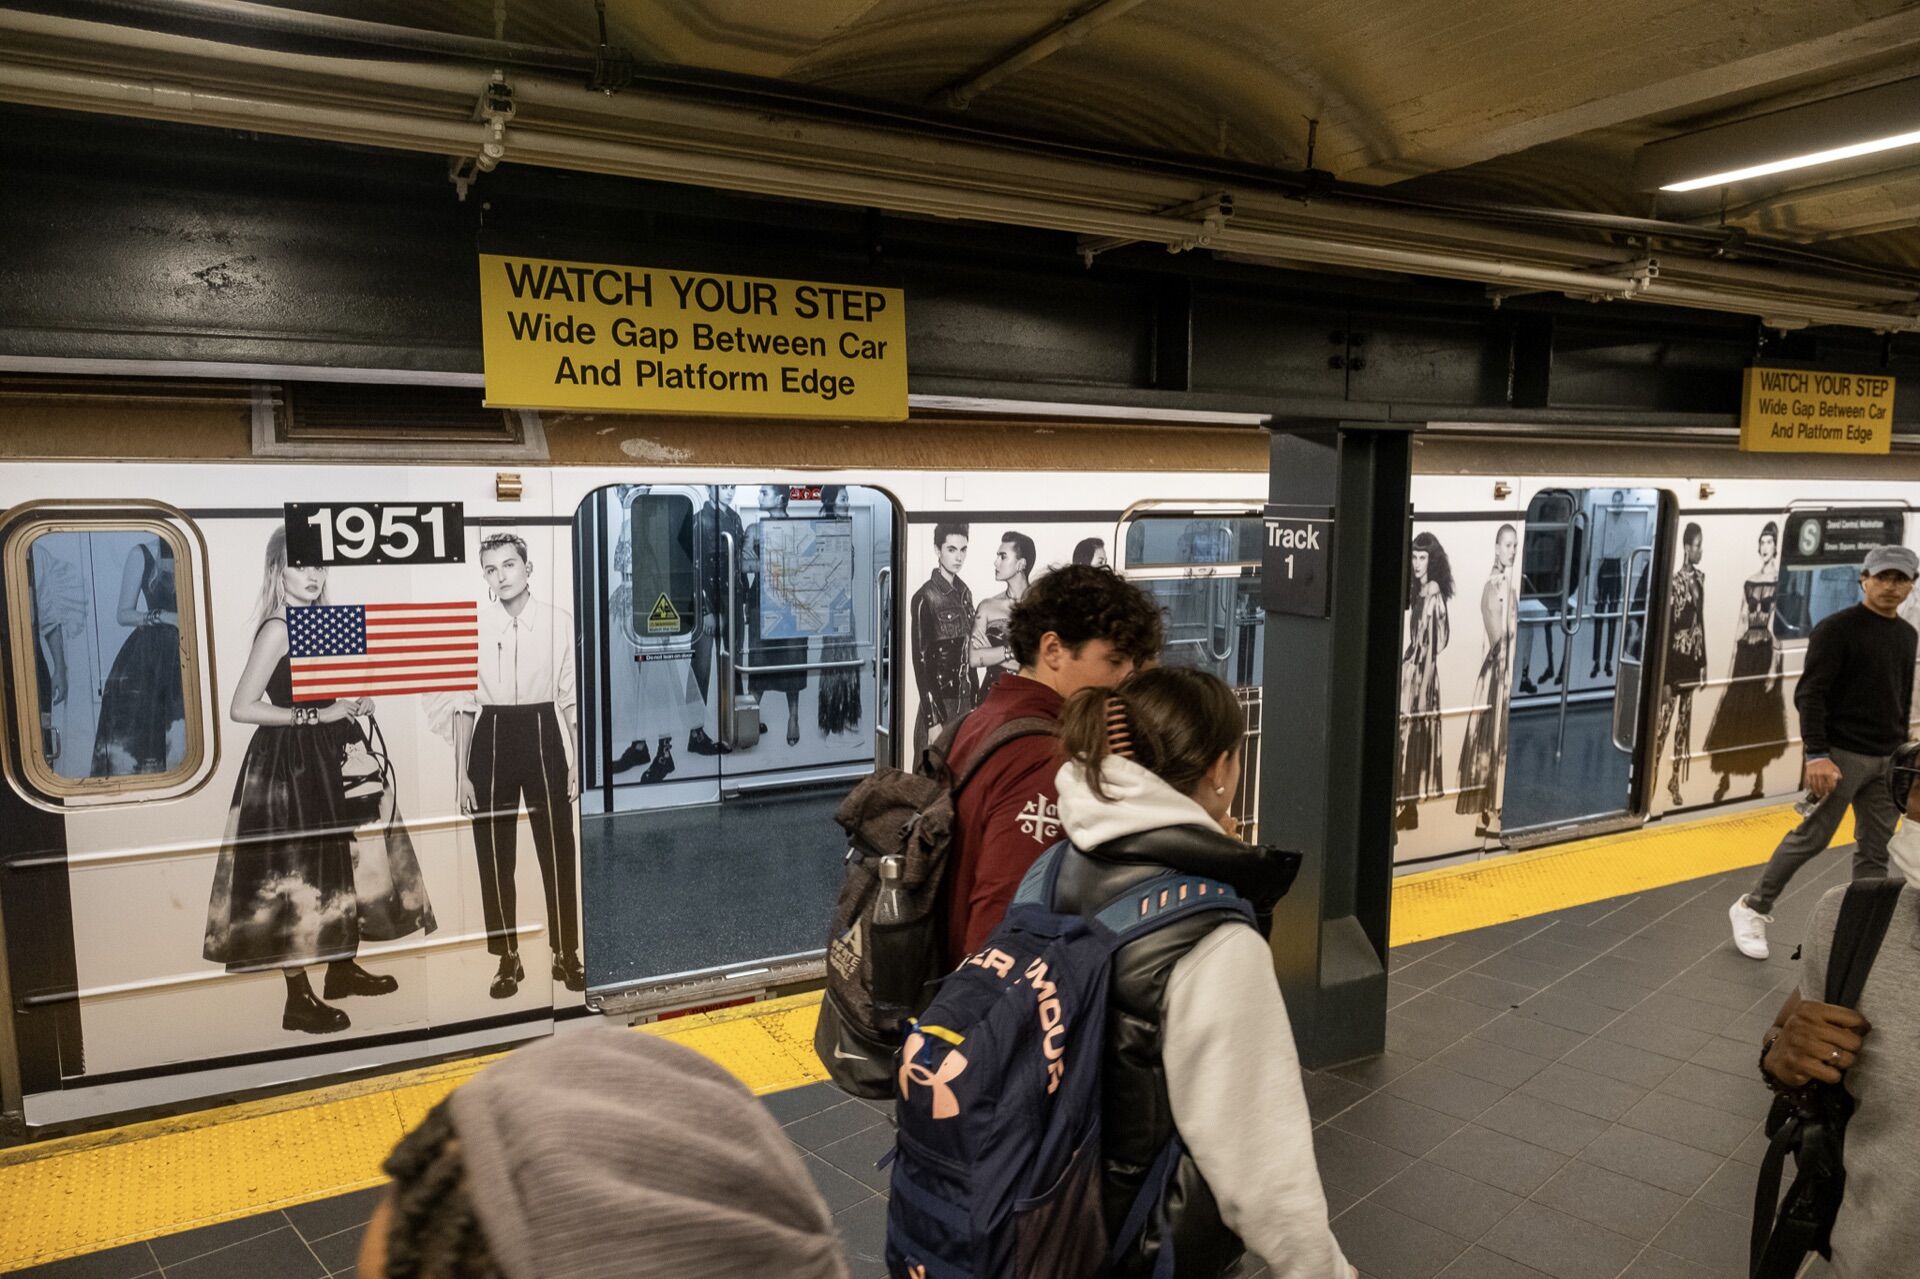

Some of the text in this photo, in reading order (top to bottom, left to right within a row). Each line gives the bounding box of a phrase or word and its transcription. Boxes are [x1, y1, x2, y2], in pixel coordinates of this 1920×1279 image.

[504, 262, 887, 322] WATCH YOUR STEP
[507, 311, 888, 360] Wide Gap Between Car
[554, 356, 856, 400] And Platform Edge
[1760, 370, 1889, 398] WATCH YOUR STEP
[1759, 398, 1887, 420] Wide Gap Between Car
[1771, 422, 1873, 444] And Platform Edge
[307, 506, 446, 561] 1951
[1265, 521, 1320, 550] Track
[1801, 522, 1818, 553] S
[1284, 554, 1294, 579] 1
